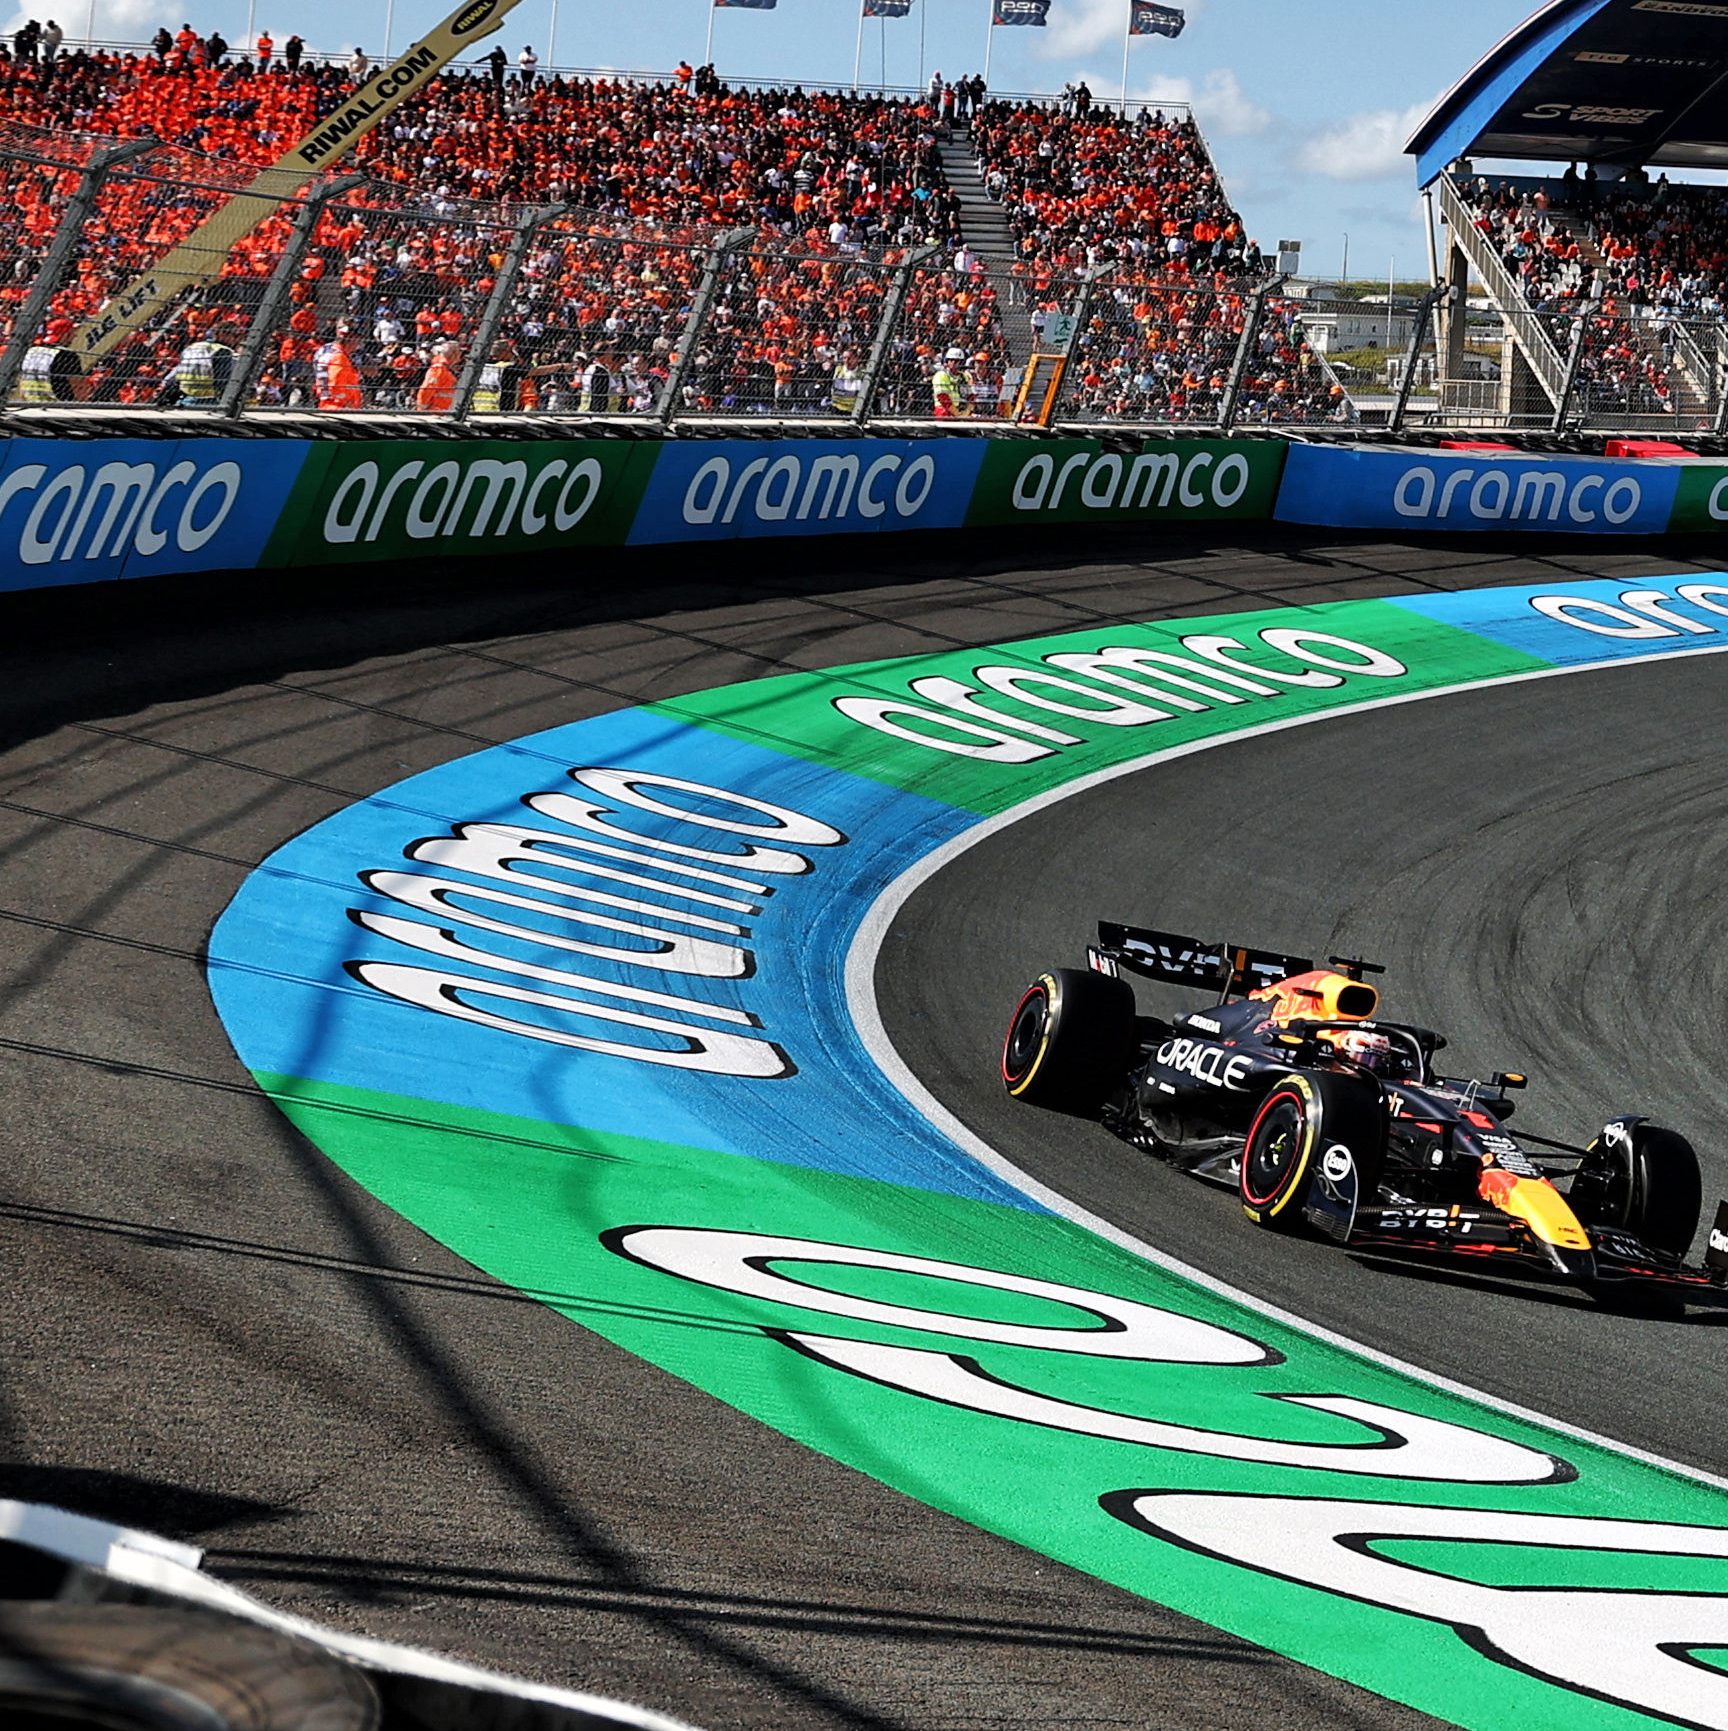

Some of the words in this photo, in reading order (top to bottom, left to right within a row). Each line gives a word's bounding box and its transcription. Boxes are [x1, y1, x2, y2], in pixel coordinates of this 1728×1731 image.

[457, 2, 493, 30] RIWAL
[1632, 57, 1708, 68] SPORTS
[297, 45, 440, 165] RIWAL.COM
[1571, 105, 1664, 117] SPORT
[118, 278, 157, 319] LIFT
[323, 458, 602, 544] aramco
[682, 454, 934, 524] aramco
[1012, 451, 1249, 510] aramco
[1393, 465, 1641, 524] aramco
[0, 460, 241, 565] ramco
[830, 626, 1407, 764] aramco
[342, 764, 848, 1080] aramco
[1188, 1014, 1222, 1034] HONDA
[1157, 1038, 1254, 1092] ORACLE
